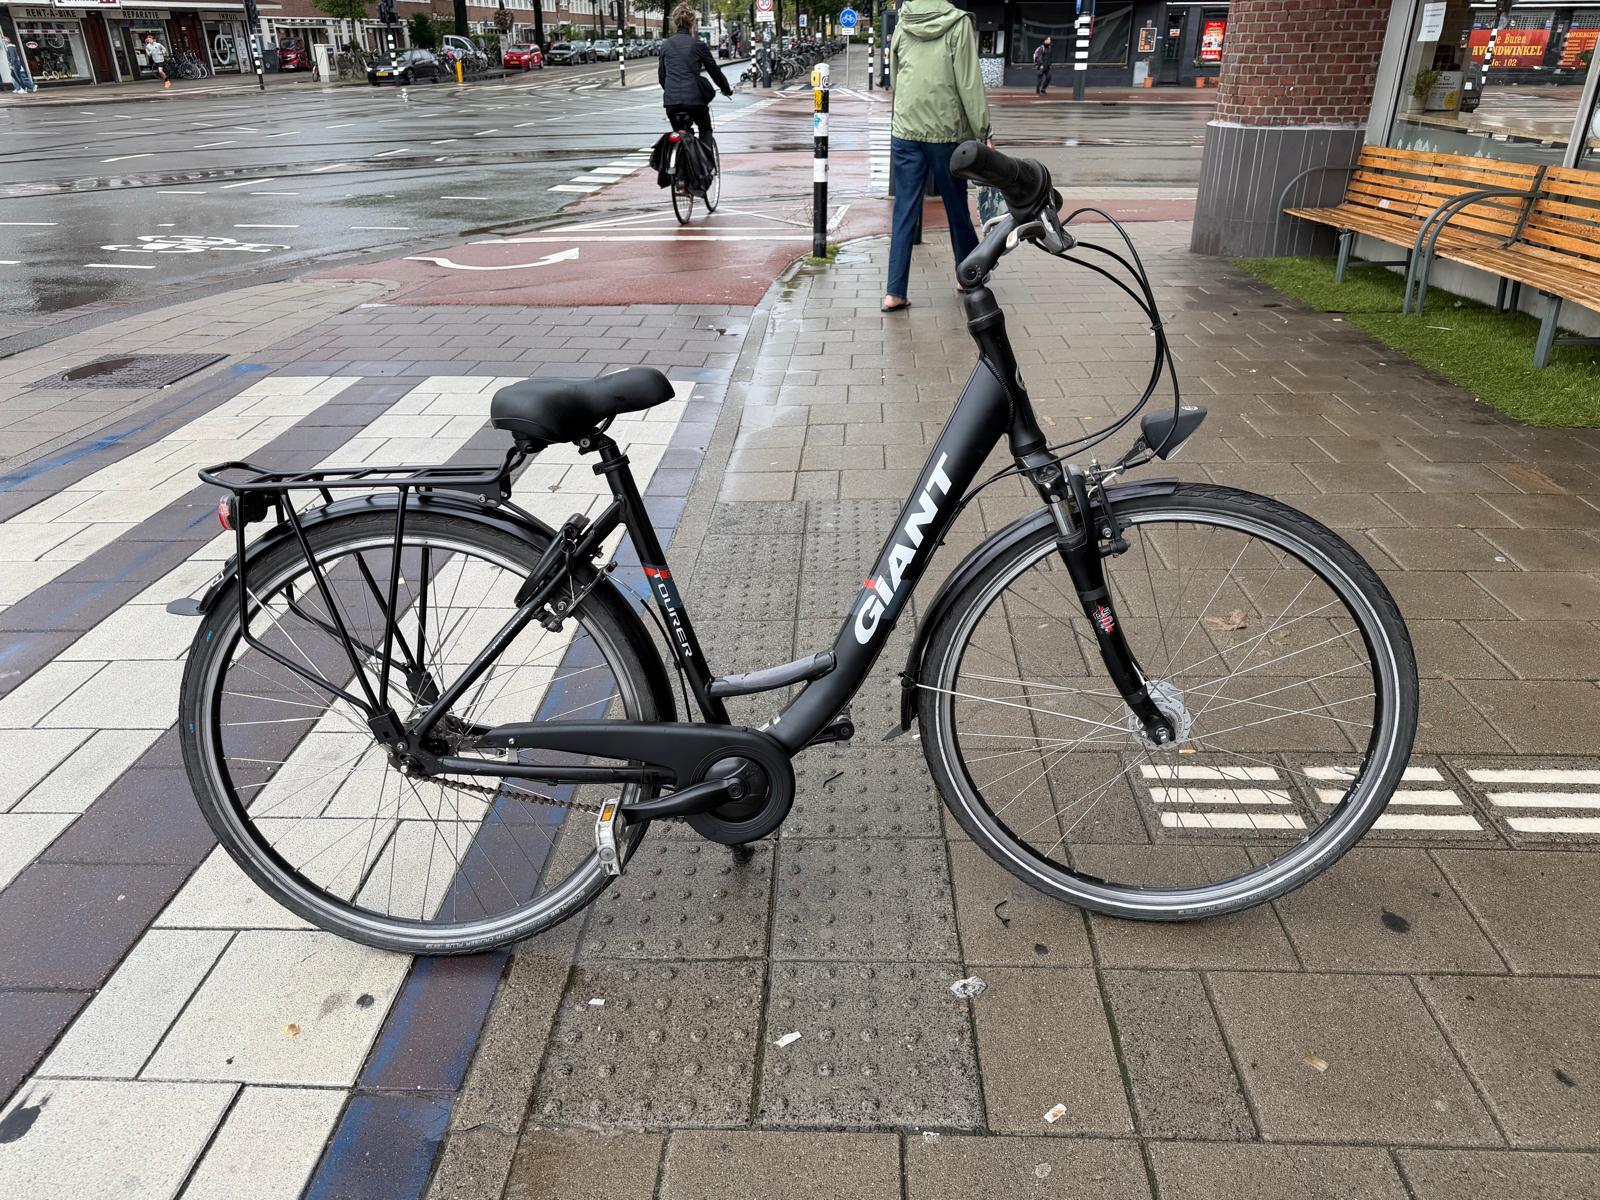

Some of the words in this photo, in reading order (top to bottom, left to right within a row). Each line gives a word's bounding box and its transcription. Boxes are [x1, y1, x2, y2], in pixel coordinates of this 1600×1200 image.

[25, 8, 77, 17] RENT-A-BIKE
[122, 10, 160, 19] REPARATIE
[1504, 33, 1526, 44] Buren
[1503, 58, 1518, 67] 102
[854, 451, 952, 645] GIANT
[653, 567, 694, 658] TOURER
